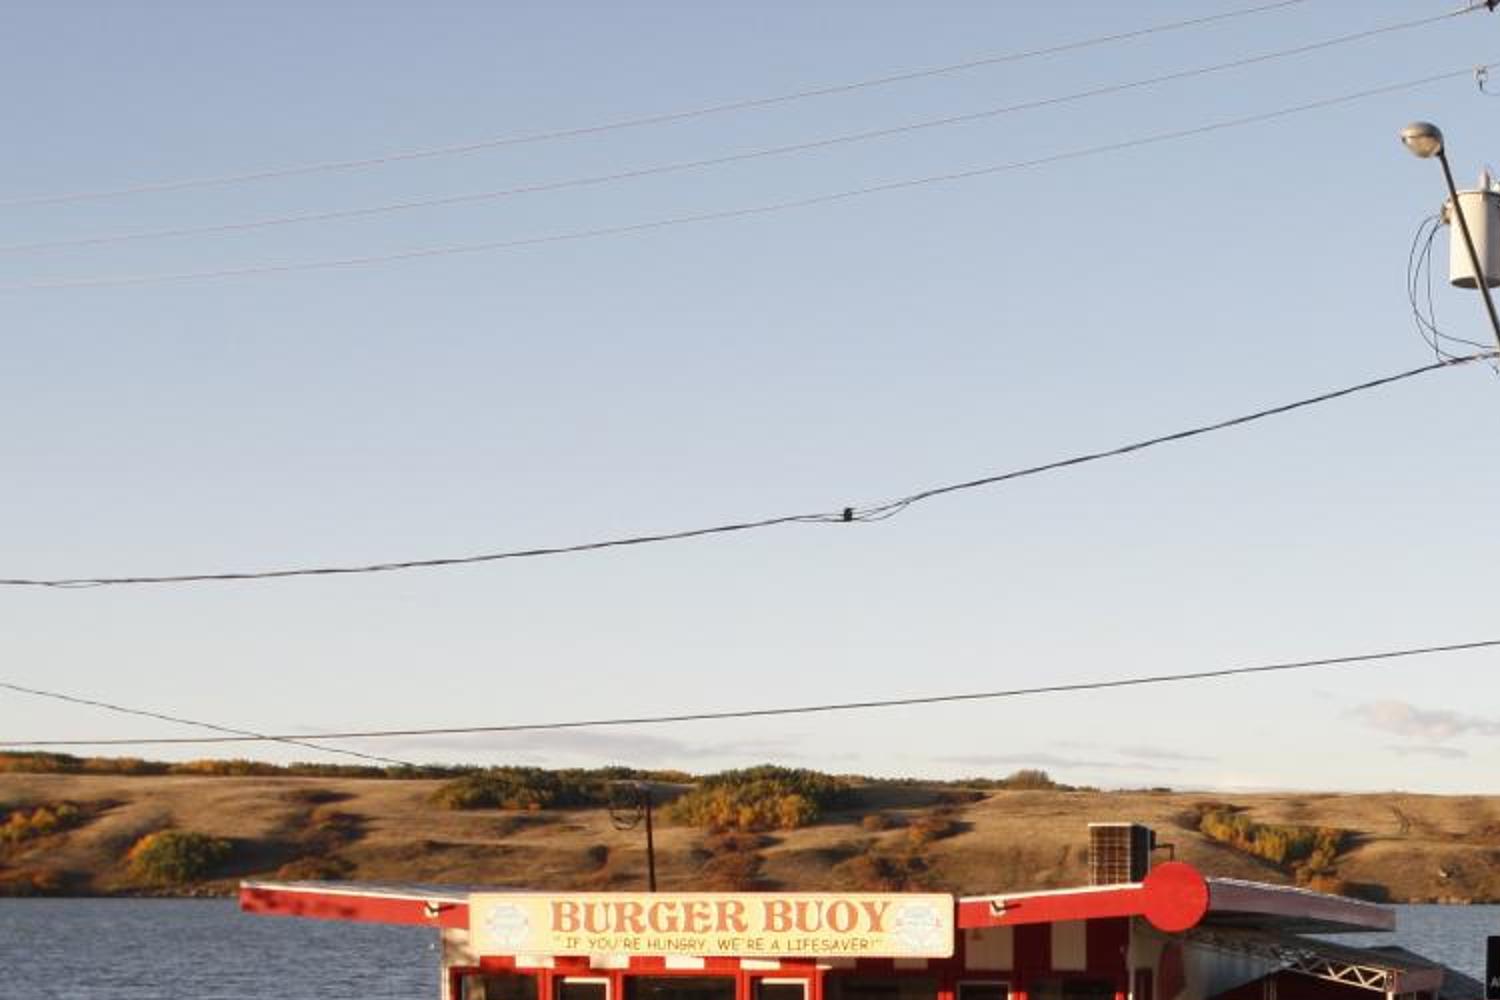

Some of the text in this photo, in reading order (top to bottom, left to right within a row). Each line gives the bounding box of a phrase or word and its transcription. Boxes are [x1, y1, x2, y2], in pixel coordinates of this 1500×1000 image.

[551, 900, 892, 934] BURGER BUOY
[589, 937, 642, 950] YOU'RE
[717, 938, 765, 951] WE'RE
[771, 939, 781, 951] A
